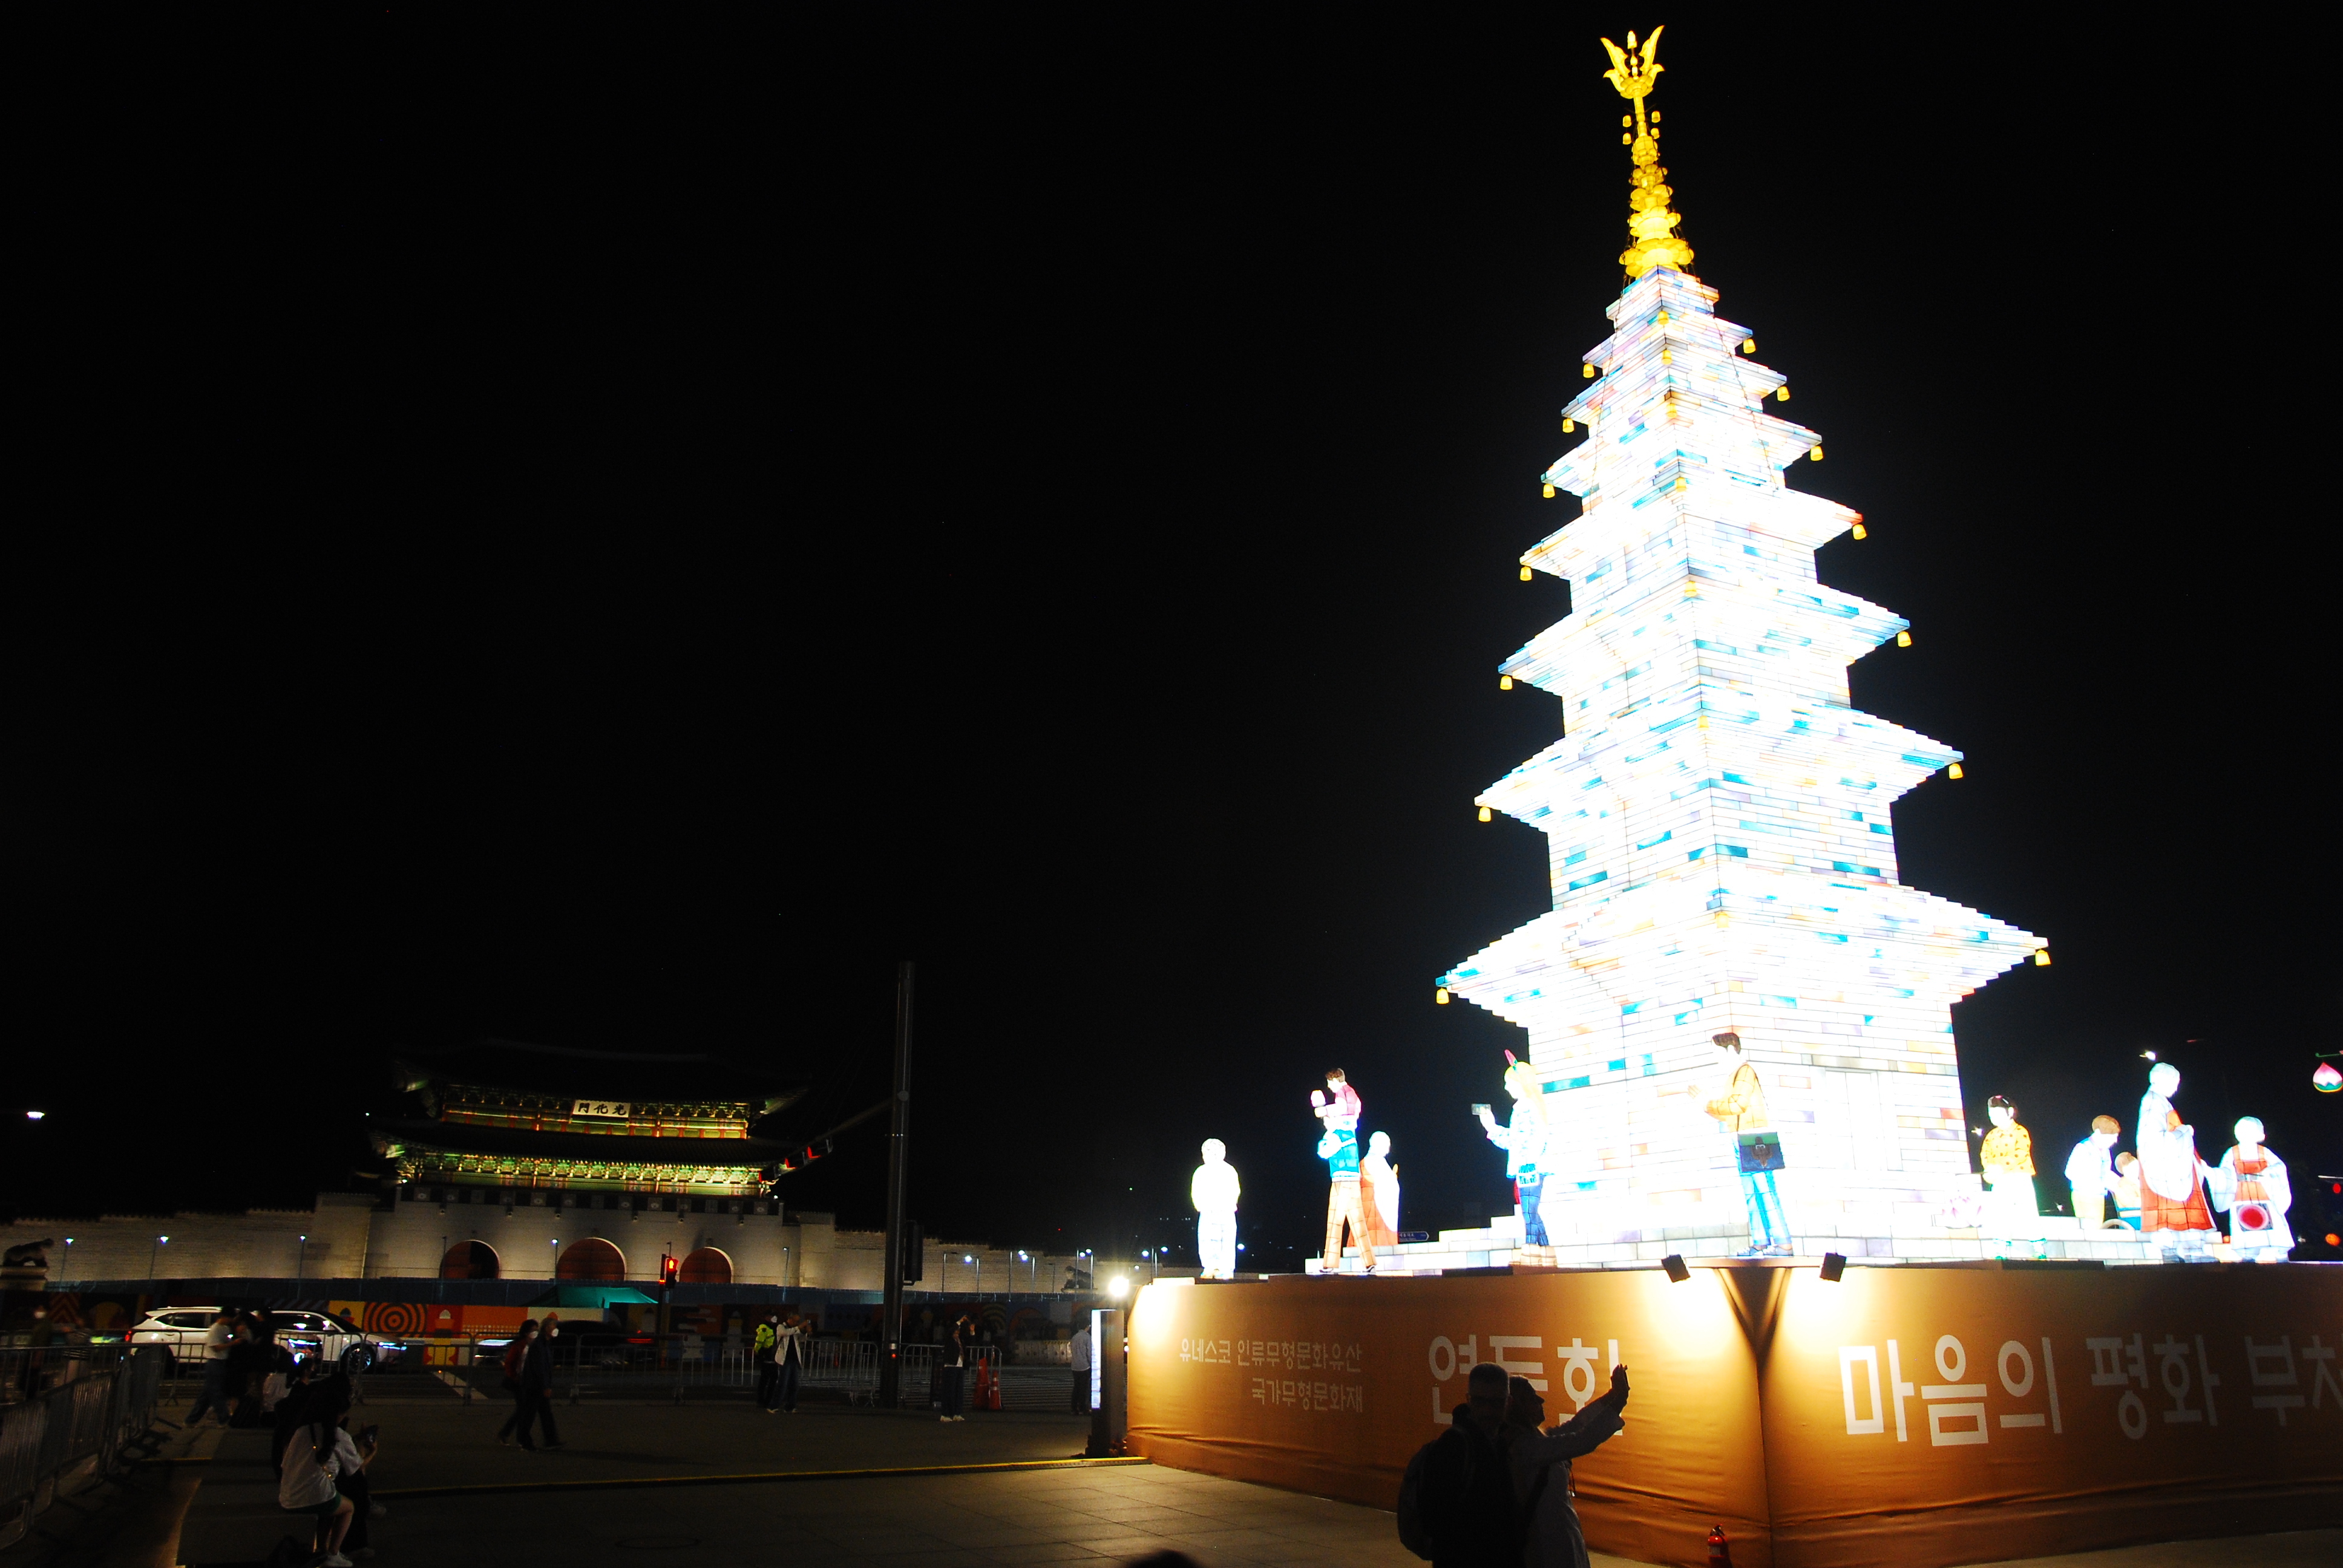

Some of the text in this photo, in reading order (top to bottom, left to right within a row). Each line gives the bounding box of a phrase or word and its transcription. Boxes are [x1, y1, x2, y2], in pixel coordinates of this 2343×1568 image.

[1179, 1338, 1362, 1373] 유네스코 인류무형문화유산
[1252, 1377, 1363, 1413] 국가무형문화재
[1838, 1334, 2062, 1446] 마음의
[2086, 1333, 2220, 1440] 평화
